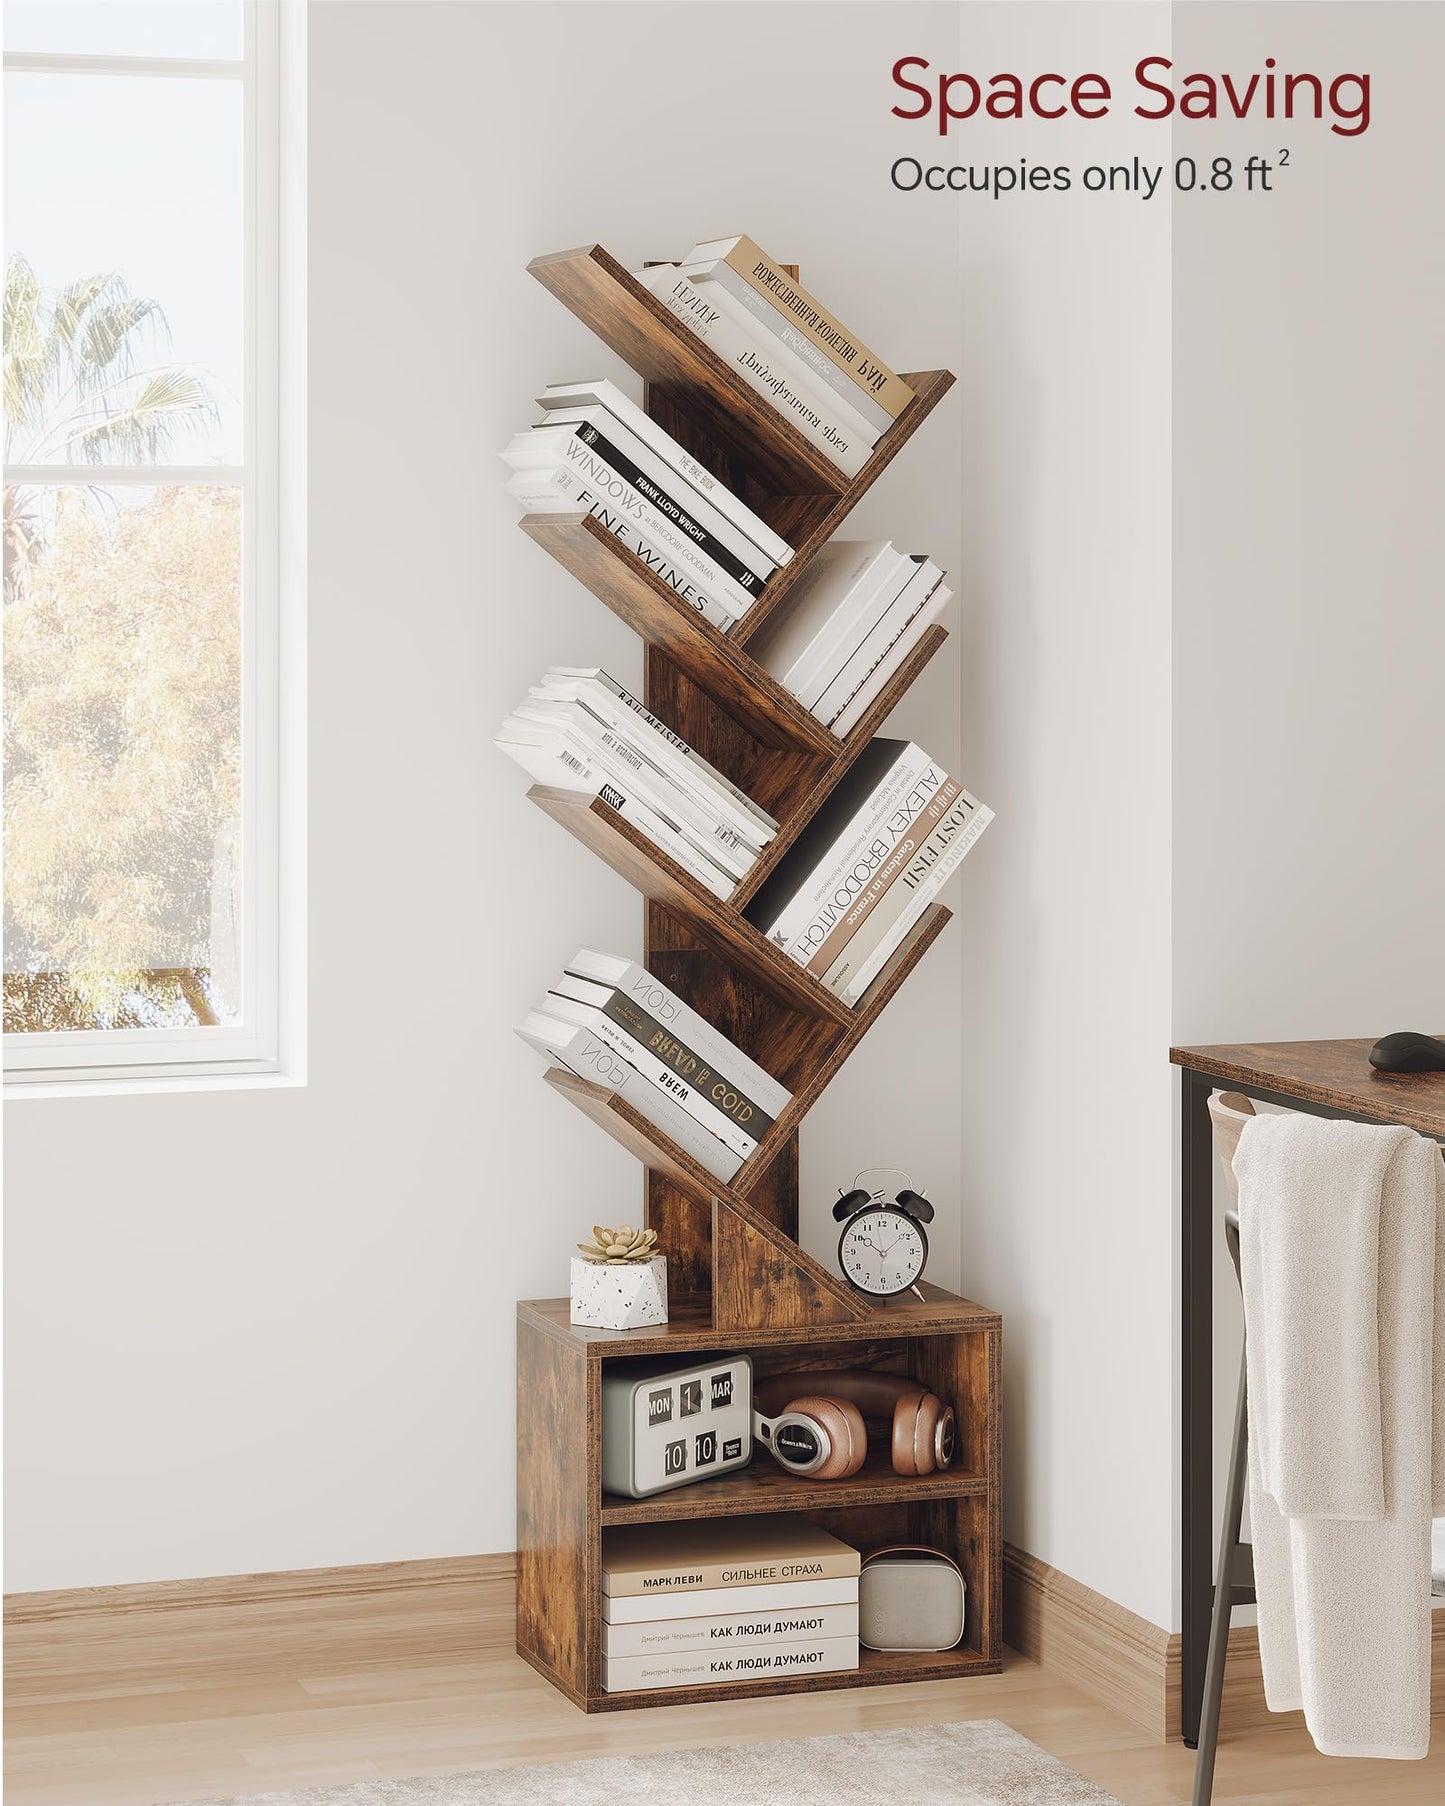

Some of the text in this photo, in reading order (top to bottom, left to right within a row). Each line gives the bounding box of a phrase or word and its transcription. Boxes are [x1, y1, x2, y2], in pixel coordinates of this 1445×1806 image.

[678, 455, 716, 492] THE BIKE BOOK
[566, 439, 648, 519] WINDOWS
[650, 519, 685, 551] BERGDORF
[681, 548, 716, 581] GOODMAN
[635, 476, 707, 542] FRANK LLOYD WRIGHT
[576, 490, 709, 612] FINE WINES
[868, 761, 908, 812] Virginia McLeod
[896, 767, 917, 792] Detail
[860, 789, 899, 837] Contemporary
[886, 768, 939, 843] ALEXEY
[935, 798, 974, 849] LOST
[837, 831, 868, 869] Residential
[880, 839, 915, 880] Gardens
[902, 845, 939, 889] FISH
[797, 838, 890, 957] BRODOVITCH
[811, 864, 844, 904] Architecture
[871, 878, 885, 891] in
[846, 890, 877, 925] France
[649, 1380, 731, 1416] MON 1 MAR
[665, 1436, 712, 1471] 10 10
[643, 1564, 823, 1587] МАРК ЛЕВИ СИЛЬНЕЕ СТРАХА
[641, 1618, 824, 1643] Дмитрий Чернышев КАК ЛЮДИ ДУМАЮТ
[641, 1652, 824, 1677] Дмитрий Чернышев КАК ЛЮДИ ДУМАЮТ
